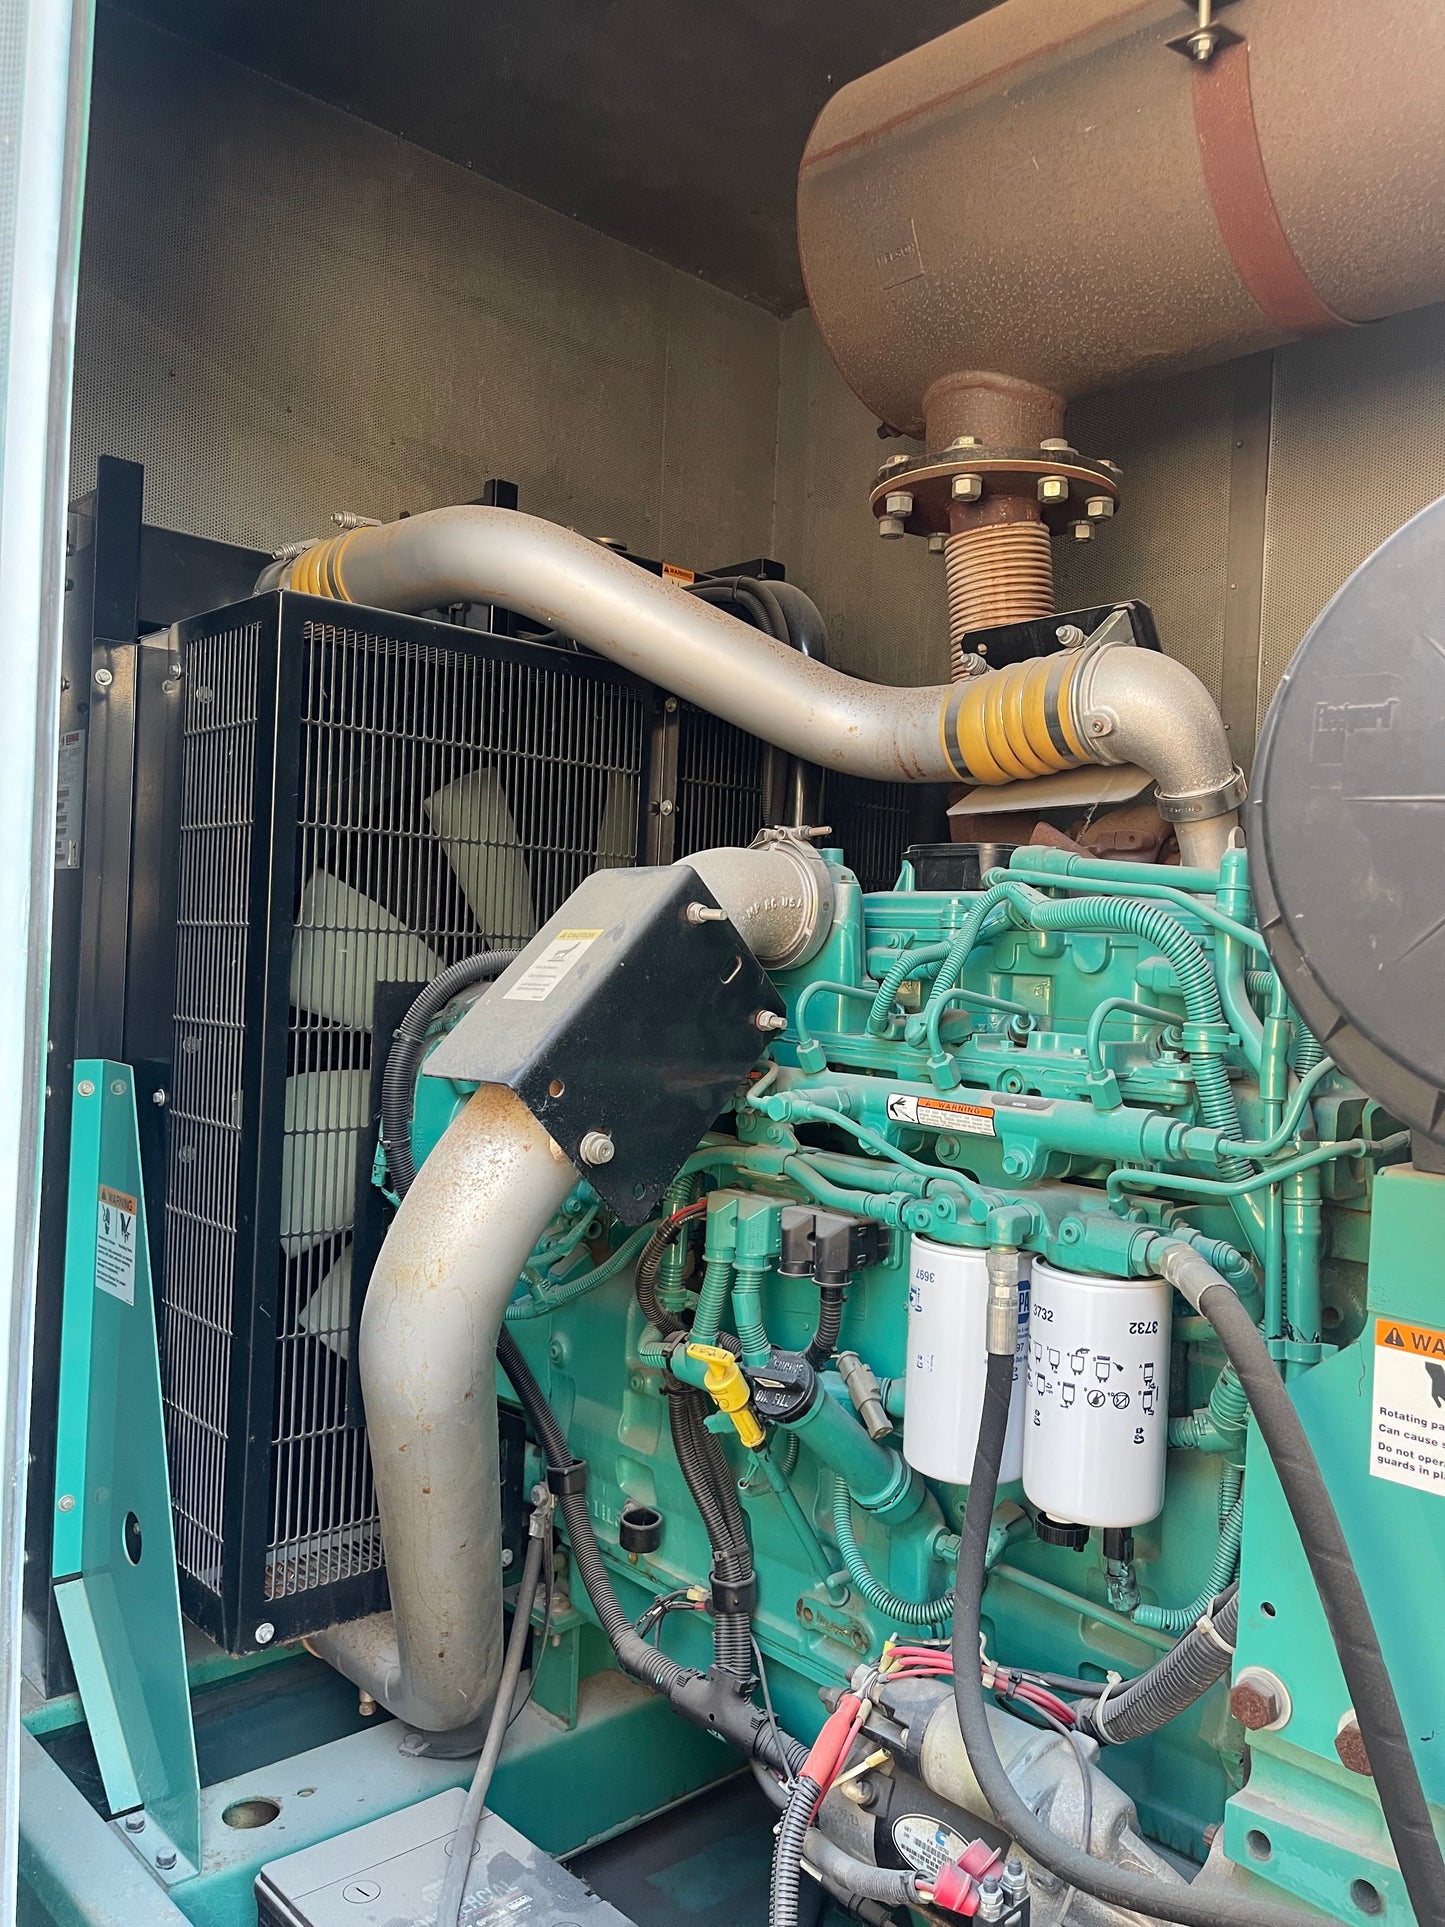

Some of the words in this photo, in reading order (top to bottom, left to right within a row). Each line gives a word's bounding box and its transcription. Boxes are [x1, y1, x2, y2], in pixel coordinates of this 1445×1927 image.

[938, 1100, 980, 1115] WARNING
[916, 1268, 935, 1283] 3697
[1033, 1304, 1054, 1322] 3732
[1129, 1321, 1158, 1334] 3732
[1379, 1406, 1428, 1428] Rotating
[1379, 1423, 1400, 1436] Can
[1403, 1432, 1438, 1447] cause
[1378, 1442, 1392, 1452] Do
[1396, 1448, 1414, 1459] not
[1418, 1454, 1445, 1467] oper
[1377, 1455, 1416, 1471] guards
[1419, 1465, 1430, 1476] in
[1433, 1471, 1445, 1480] pl
